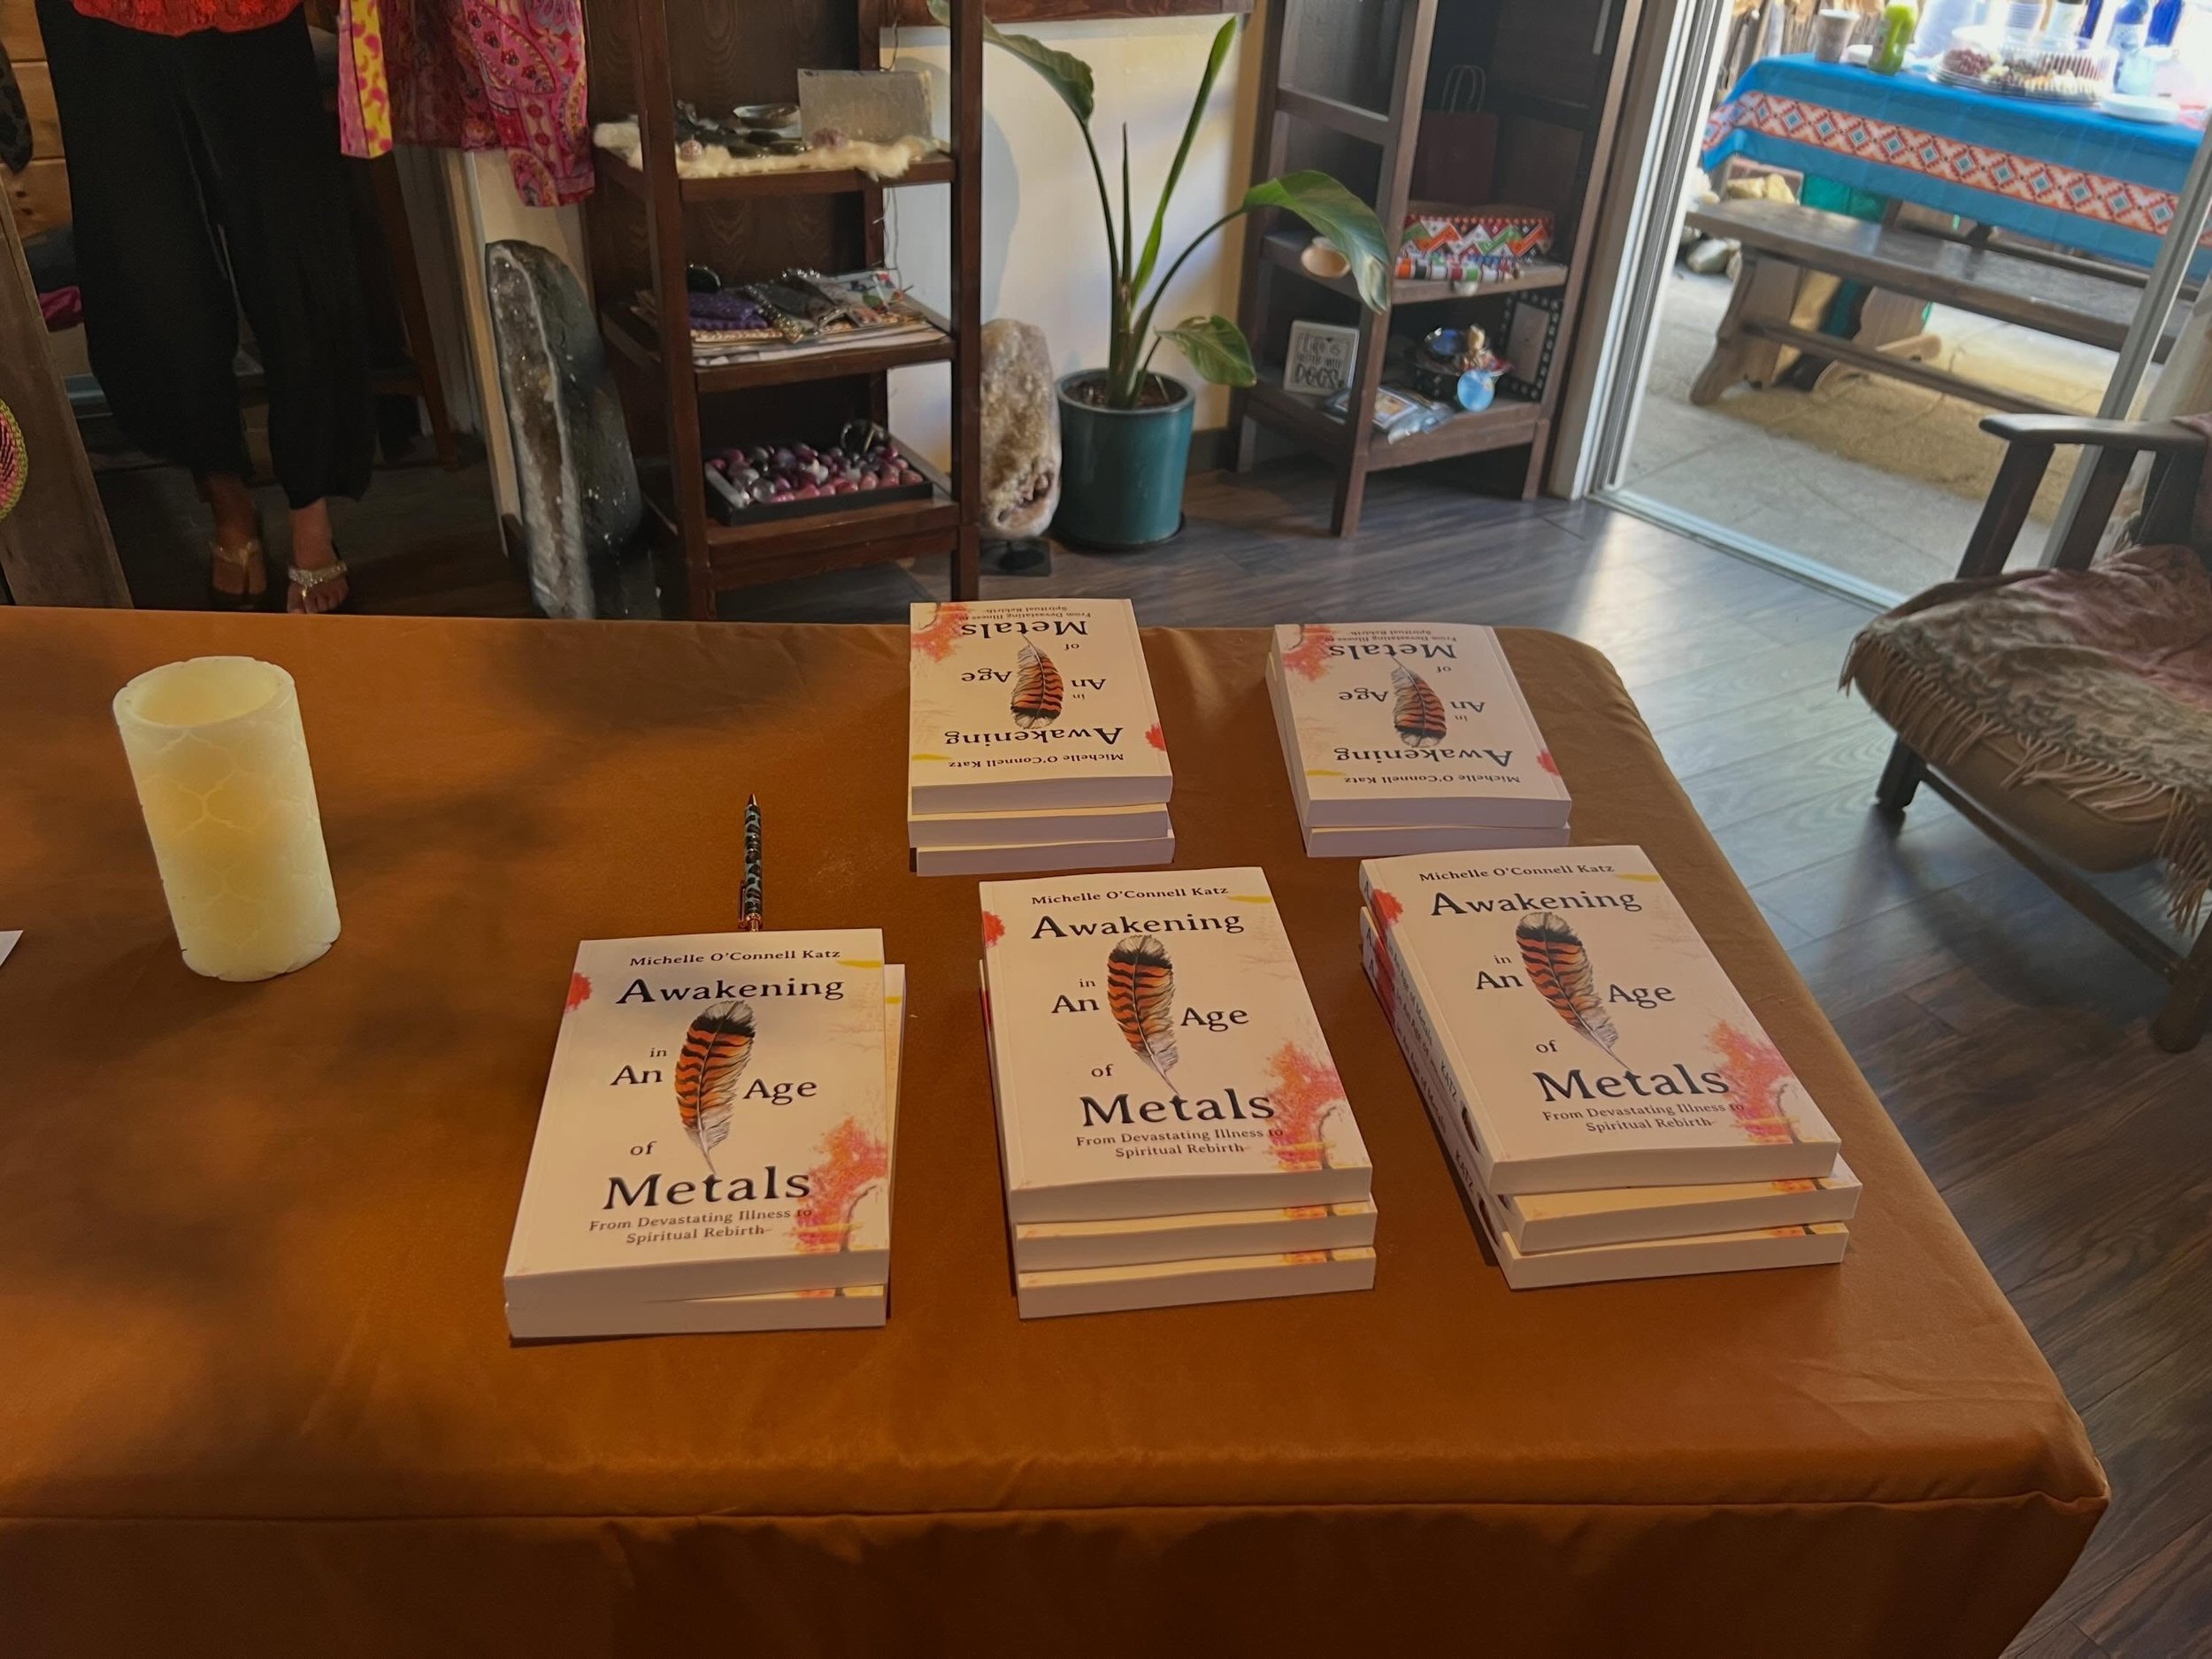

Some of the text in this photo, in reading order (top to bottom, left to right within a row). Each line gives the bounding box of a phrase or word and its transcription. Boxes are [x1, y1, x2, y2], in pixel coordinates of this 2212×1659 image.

[963, 620, 1088, 639] Metals
[1330, 643, 1457, 660] Metals
[962, 667, 1106, 690] An Age
[1339, 687, 1486, 713] An Age
[945, 726, 1123, 746] Awakening
[986, 756, 1058, 764] O'Connell
[1334, 747, 1513, 767] Awakening
[1459, 774, 1520, 783] Michelle
[1419, 864, 1614, 881] Michelle O'Connell Katz
[1032, 886, 1228, 904] Michelle O'Connell Katz
[1431, 891, 1642, 916] Awakening
[1031, 914, 1244, 940] Awakening
[630, 949, 841, 966] Michelle O'Connell Katz
[1494, 954, 1511, 964] in
[616, 977, 844, 1003] Awakening
[1079, 978, 1095, 987] in
[1476, 971, 1676, 1009] An Age
[1051, 995, 1249, 1032] An Age
[649, 1048, 667, 1057] in
[1536, 1040, 1557, 1054] of
[1091, 1064, 1113, 1077] of
[1440, 1059, 1457, 1102] KATZ
[610, 1064, 818, 1104] An Age
[1532, 1064, 1729, 1102] Metals
[1079, 1088, 1274, 1126] Metals
[1542, 1102, 1744, 1122] From Devastating Illness to
[1586, 1120, 1652, 1133] Spiritual
[1076, 1127, 1283, 1147] From Devastating Illness to
[631, 1141, 657, 1155] of
[1115, 1145, 1182, 1158] Spiritual
[1455, 1148, 1473, 1194] KATZ
[603, 1166, 810, 1210] Metals
[589, 1208, 811, 1231] From Devastating Illness to
[626, 1229, 697, 1244] Spiritual
